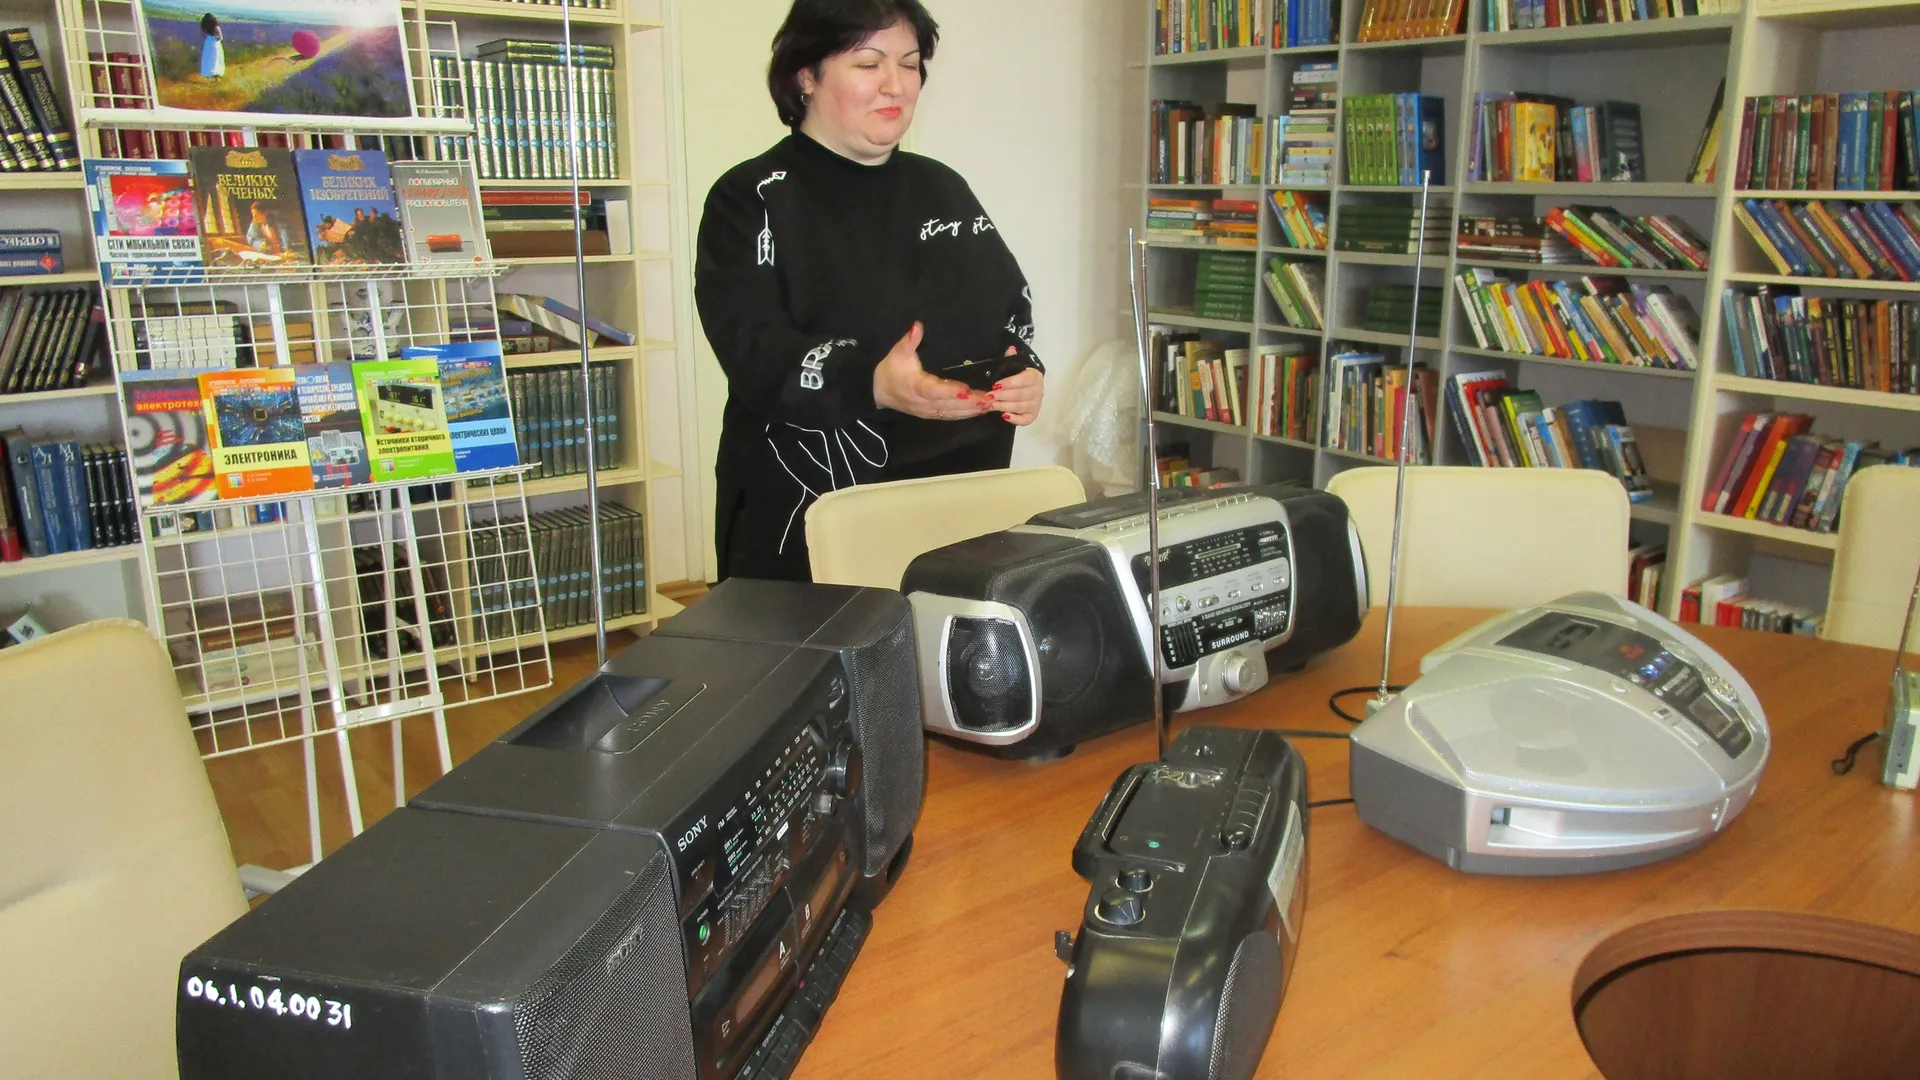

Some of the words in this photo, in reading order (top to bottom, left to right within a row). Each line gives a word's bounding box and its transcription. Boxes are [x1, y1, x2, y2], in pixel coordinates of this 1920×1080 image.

[216, 174, 278, 187] ВЕЛИКИХ
[321, 176, 376, 188] ВЕЛИКИХ
[408, 177, 459, 186] ПОПУЛЯРНЫЙ
[223, 186, 277, 200] УЧЕНЫХ
[310, 187, 389, 200] ИЗОБРЕТЕНИЙ
[406, 199, 469, 207] РАДИОЛЮБИТЕЛЯ
[920, 218, 962, 241] stay
[107, 239, 124, 249] СЕТИ
[126, 238, 171, 249] МОБИЛЬНОЙ
[172, 239, 197, 249] СВЯЗИ
[135, 400, 200, 411] электротех
[376, 436, 410, 446] Источники
[410, 433, 446, 443] вторичного
[450, 428, 489, 440] лектрических
[378, 443, 429, 454] электропитания
[224, 448, 298, 465] ЭЛЕКТРОНИКА
[1211, 630, 1250, 649] SURROUND
[677, 815, 708, 853] SONY
[803, 903, 812, 922] B
[779, 940, 787, 960] A
